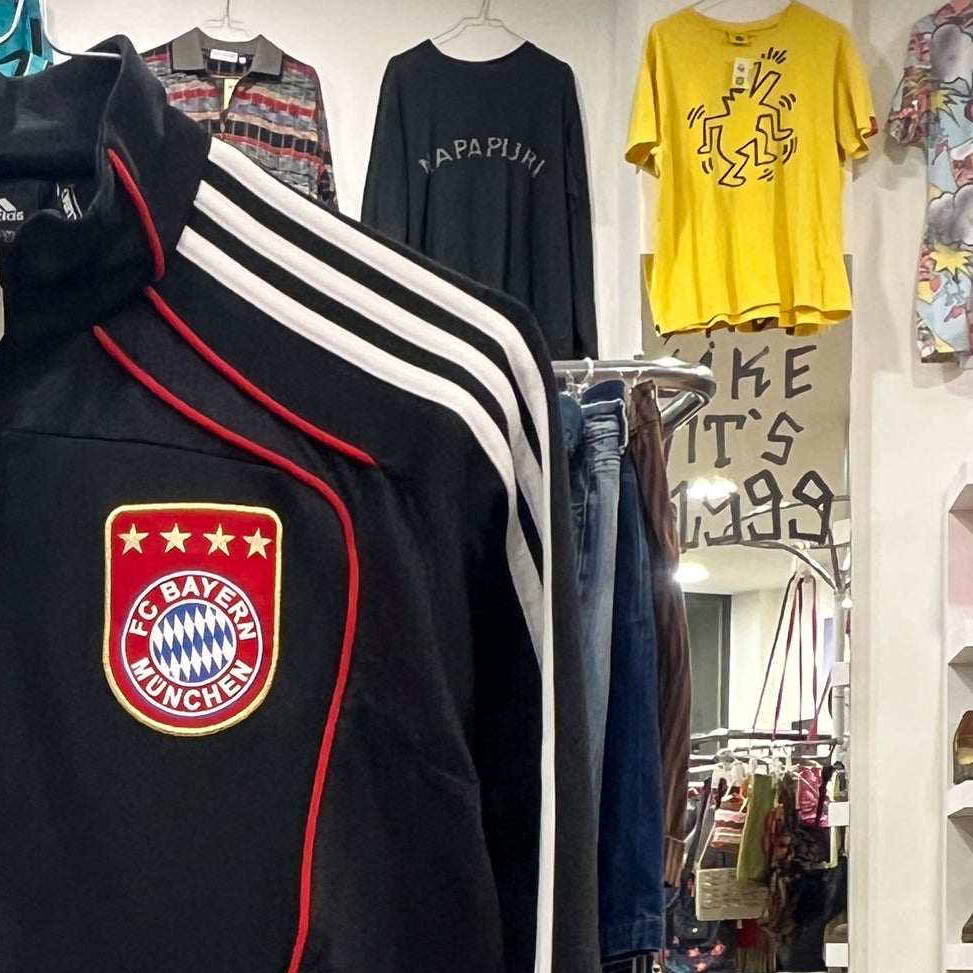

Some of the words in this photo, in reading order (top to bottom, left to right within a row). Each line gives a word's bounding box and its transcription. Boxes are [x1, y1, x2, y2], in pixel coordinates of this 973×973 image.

[129, 600, 158, 637] FC
[159, 576, 257, 641] BAYERN
[130, 656, 254, 711] MÜNCHEN
